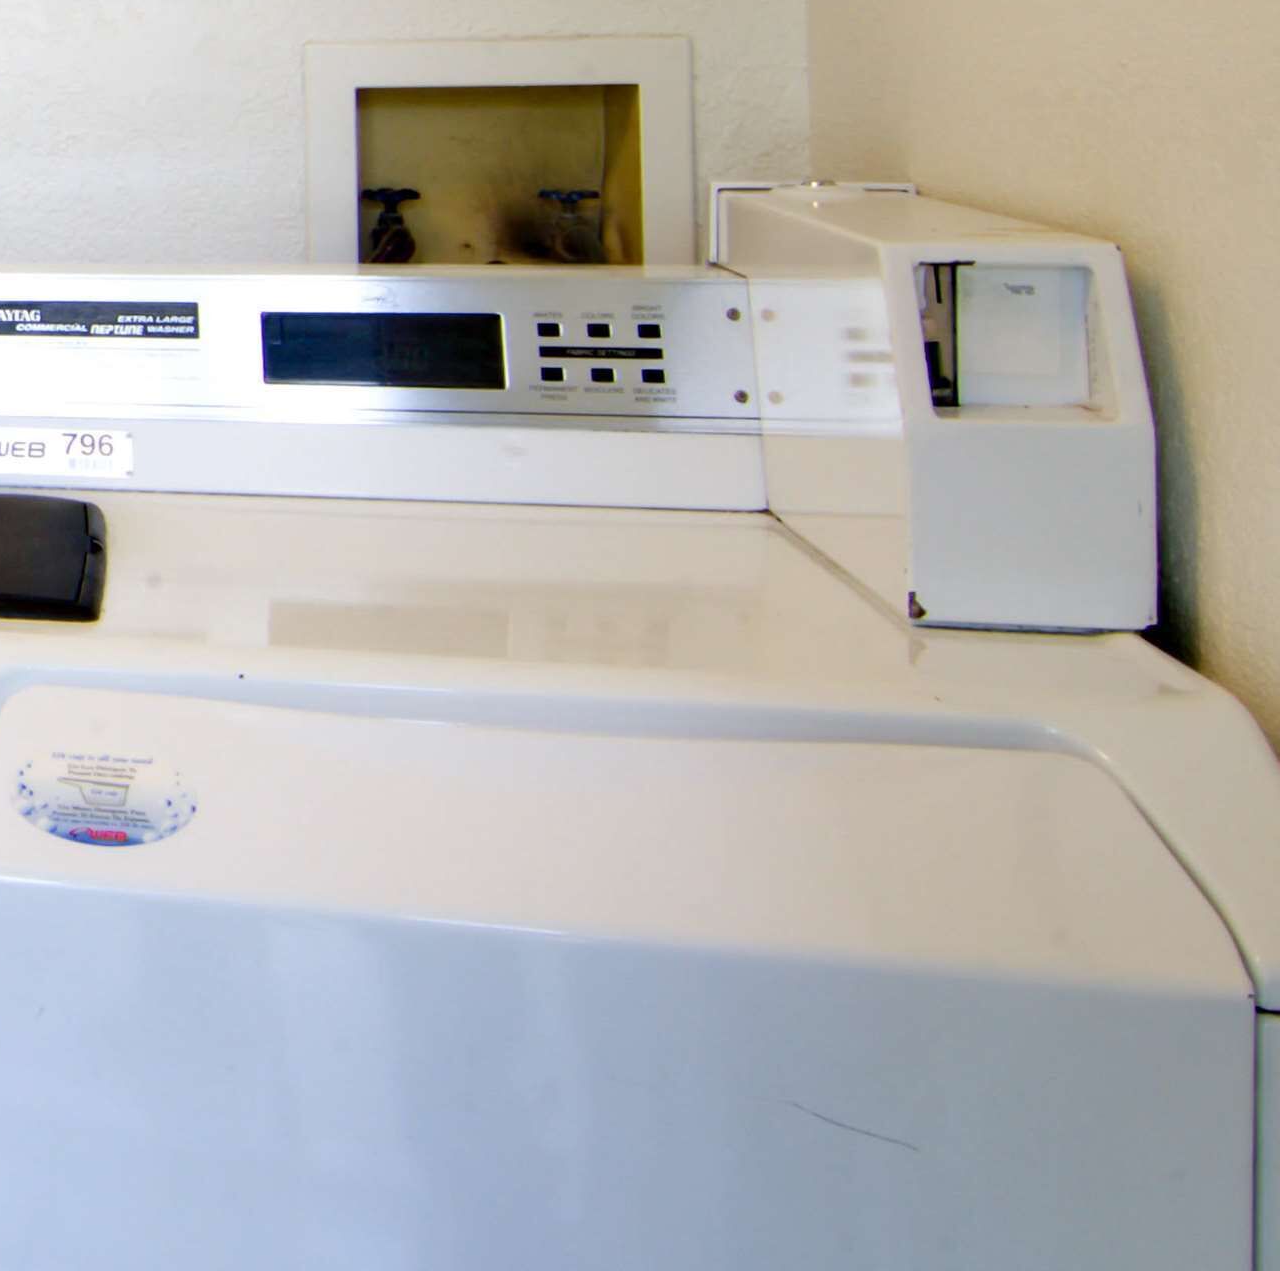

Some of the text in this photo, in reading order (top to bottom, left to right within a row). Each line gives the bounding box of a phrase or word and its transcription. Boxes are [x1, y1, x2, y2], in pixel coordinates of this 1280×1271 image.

[117, 314, 194, 325] EXTRA LARGE
[15, 323, 88, 333] COMMERCIAL
[146, 326, 195, 335] WASHER
[61, 433, 114, 457] 796
